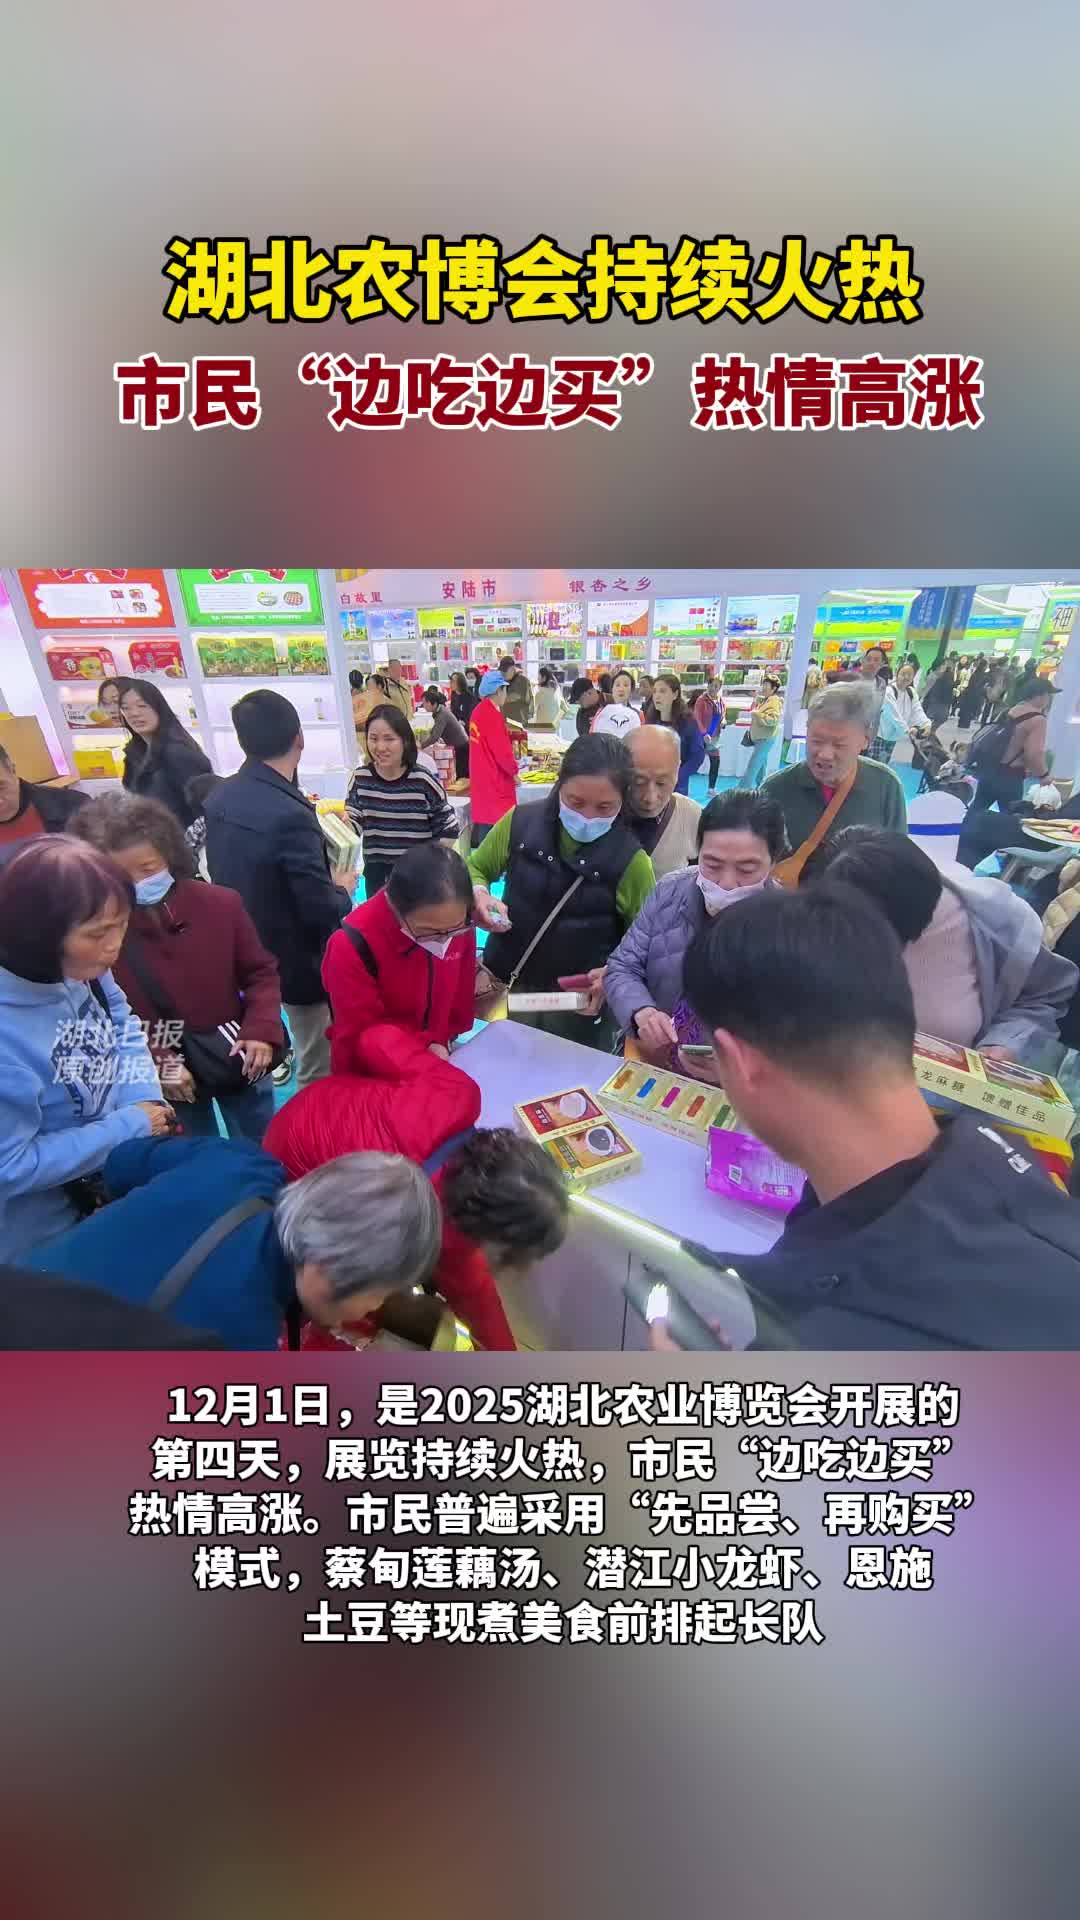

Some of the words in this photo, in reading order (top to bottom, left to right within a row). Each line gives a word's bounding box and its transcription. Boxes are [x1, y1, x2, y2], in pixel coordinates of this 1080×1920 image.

[442, 578, 497, 600] 安陆市
[568, 576, 652, 593] 银杏之乡
[340, 591, 383, 605] 白故里
